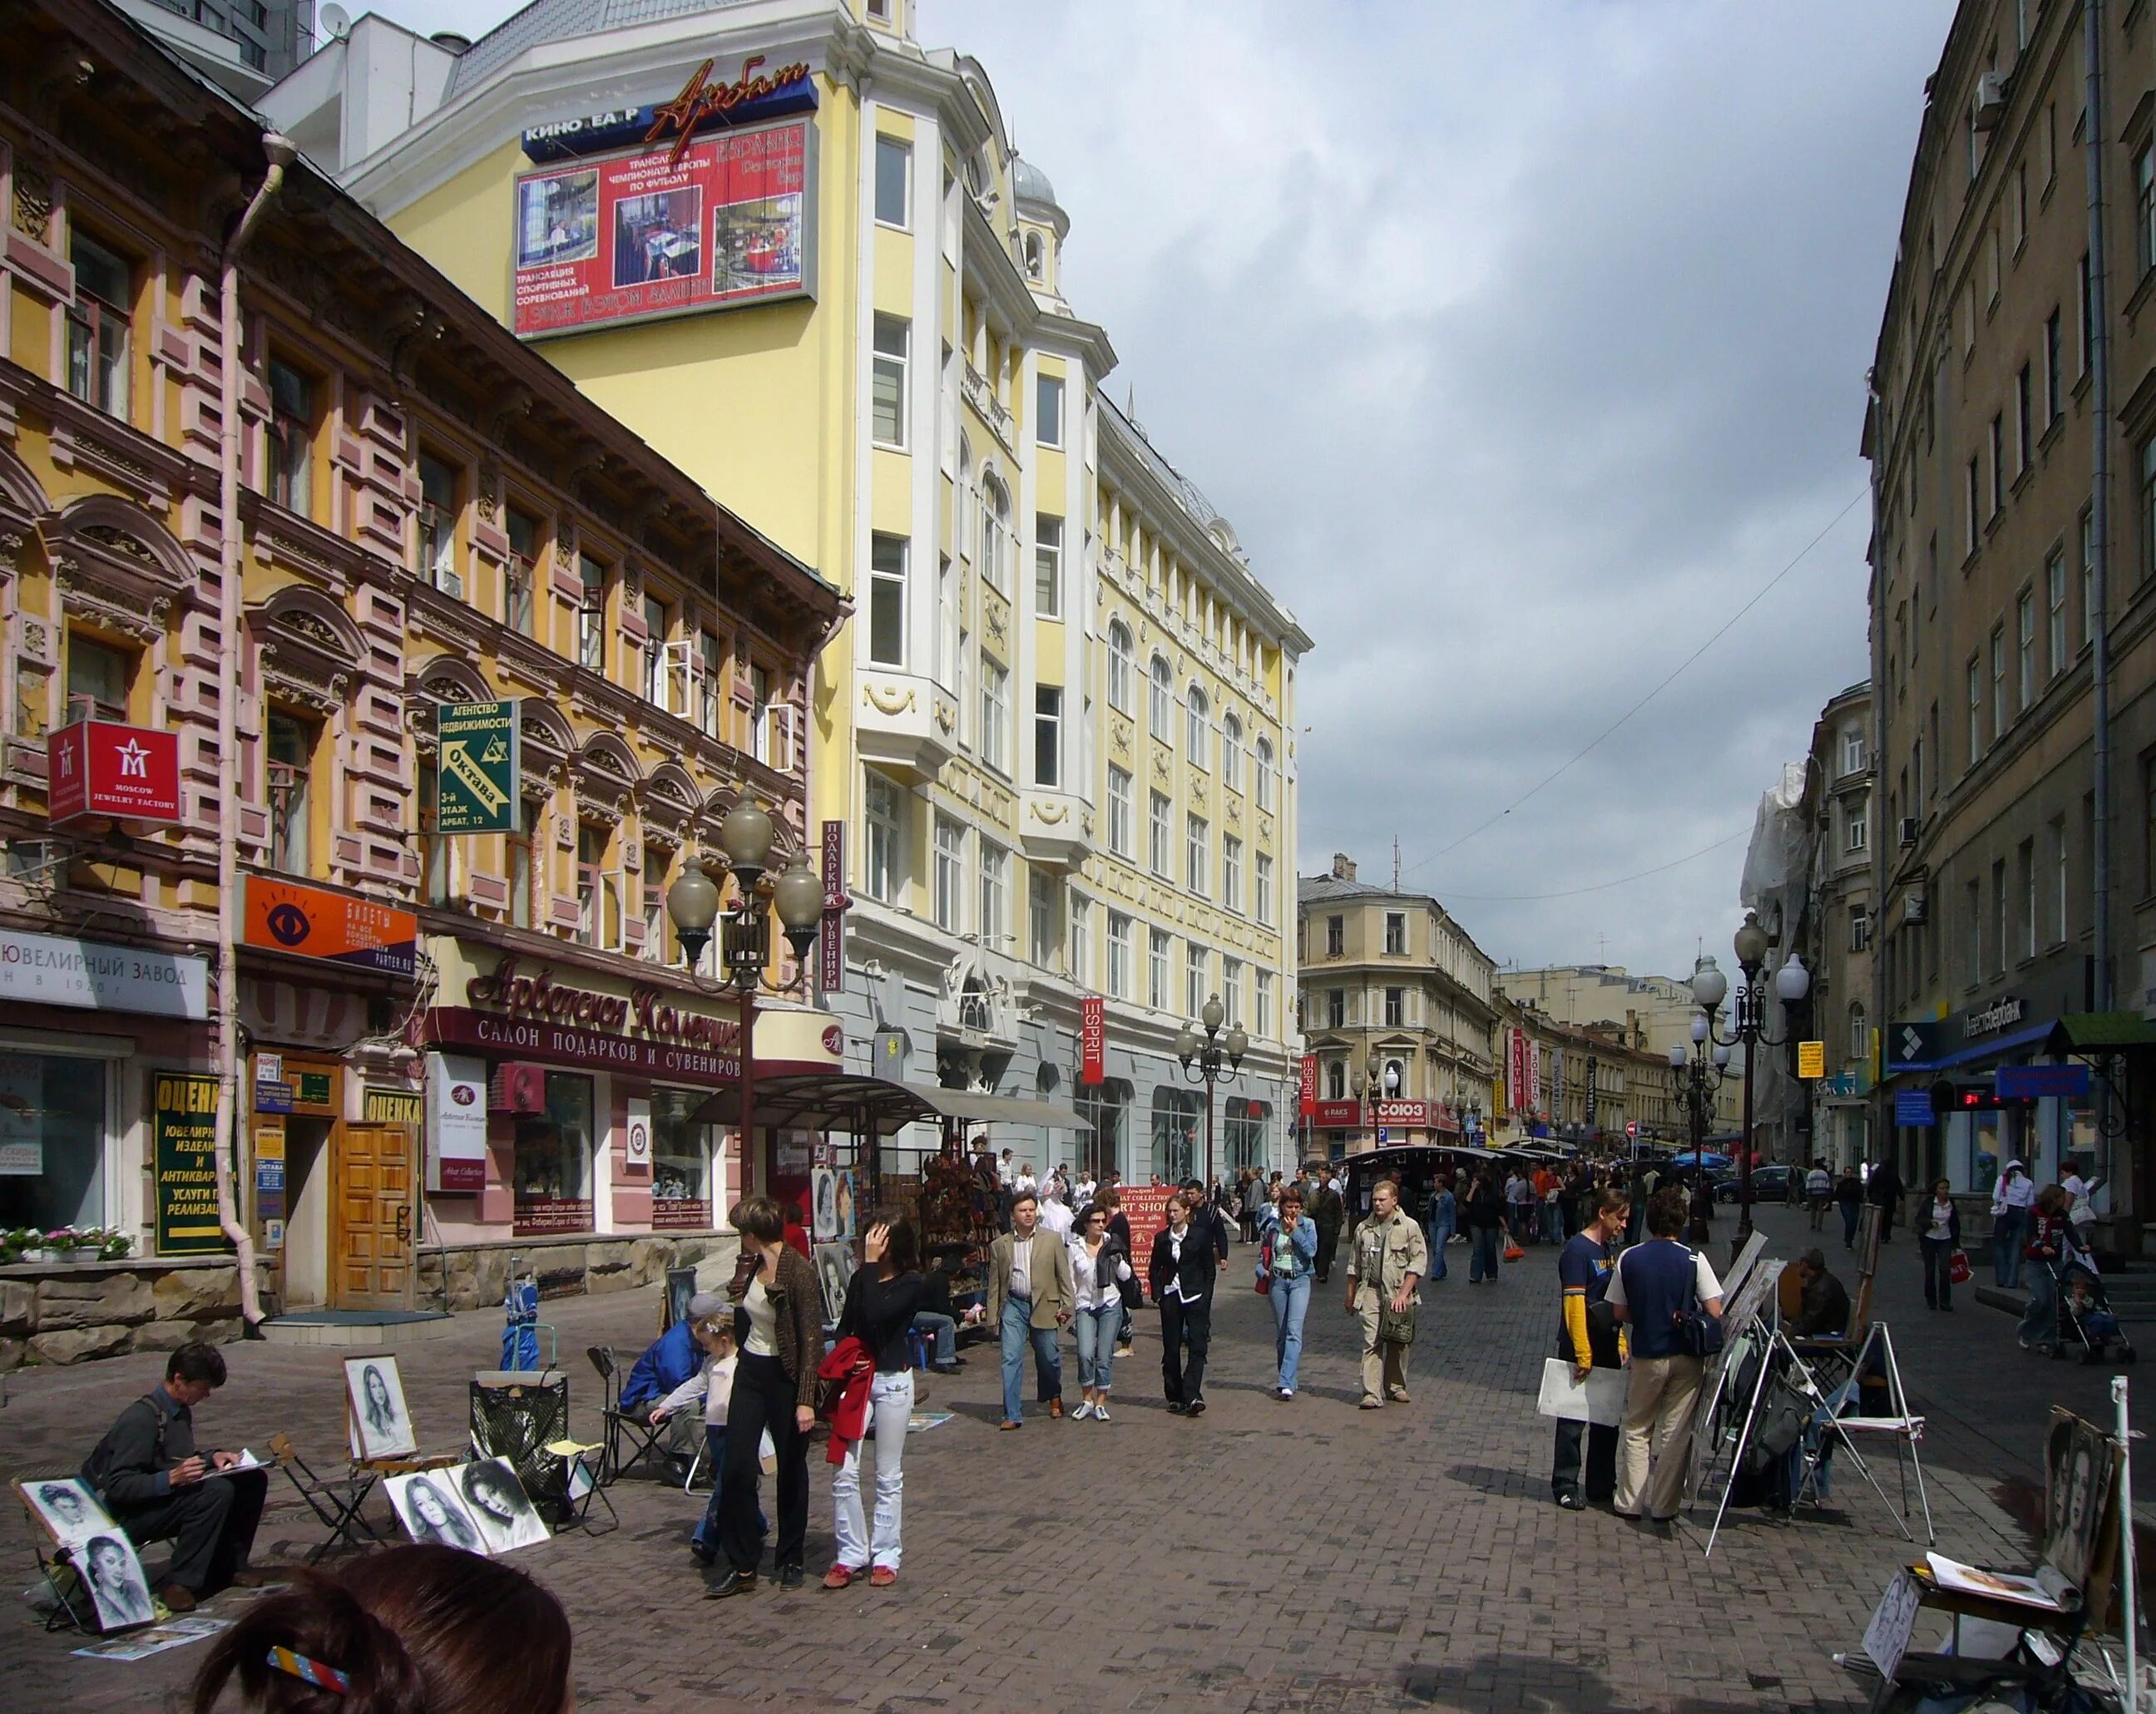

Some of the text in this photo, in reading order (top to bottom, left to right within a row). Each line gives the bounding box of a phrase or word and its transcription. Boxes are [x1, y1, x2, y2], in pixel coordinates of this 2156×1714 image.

[630, 151, 690, 170] ТРАНСЛЯ
[630, 173, 689, 192] ПО ФУТБОЛУ
[517, 267, 574, 284] ТРАНСЛЯЦИЯ
[517, 277, 577, 295] СПОРТИВНЫХ
[517, 286, 590, 305] СОРЕВНОВАНИЙ
[452, 703, 499, 717] АГЕНТСТВО
[439, 718, 512, 734] НЕДВИЖИМОСТИ
[449, 748, 497, 803] Октава
[115, 783, 154, 794] MOSCOW
[93, 793, 176, 809] JEWELRY FACTORY
[441, 793, 457, 803] 3-й
[441, 805, 468, 815] ЭТАЖ
[441, 816, 483, 827] АРБАТ, 12
[826, 822, 838, 891] ПОДАРКИ
[347, 902, 391, 928] БИЛЕТЫ
[2, 945, 187, 985] ЮВЕЛИРНЫЙ ЗАВОД
[375, 953, 413, 971] PARTER.RU
[1085, 1003, 1100, 1064] ESPRIT
[477, 1020, 742, 1078] САЛОН ПОДАРКОВ И СУВЕНИРОВ
[1303, 1060, 1314, 1102] ESPRIT
[158, 1080, 221, 1115] ОЦЕНК
[368, 1094, 422, 1124] ОЦЕНКА
[1377, 1104, 1423, 1117] СОЮЗ
[165, 1124, 215, 1139] ЮВЕЛИРН
[176, 1139, 215, 1153] ИЗДЕЛИ
[195, 1156, 205, 1168] И
[161, 1169, 237, 1183] АНТИКВАРА
[172, 1187, 210, 1201] УСЛУГИ
[167, 1203, 220, 1216] РЕАЛИЗАЦ
[1120, 1203, 1135, 1213] RT
